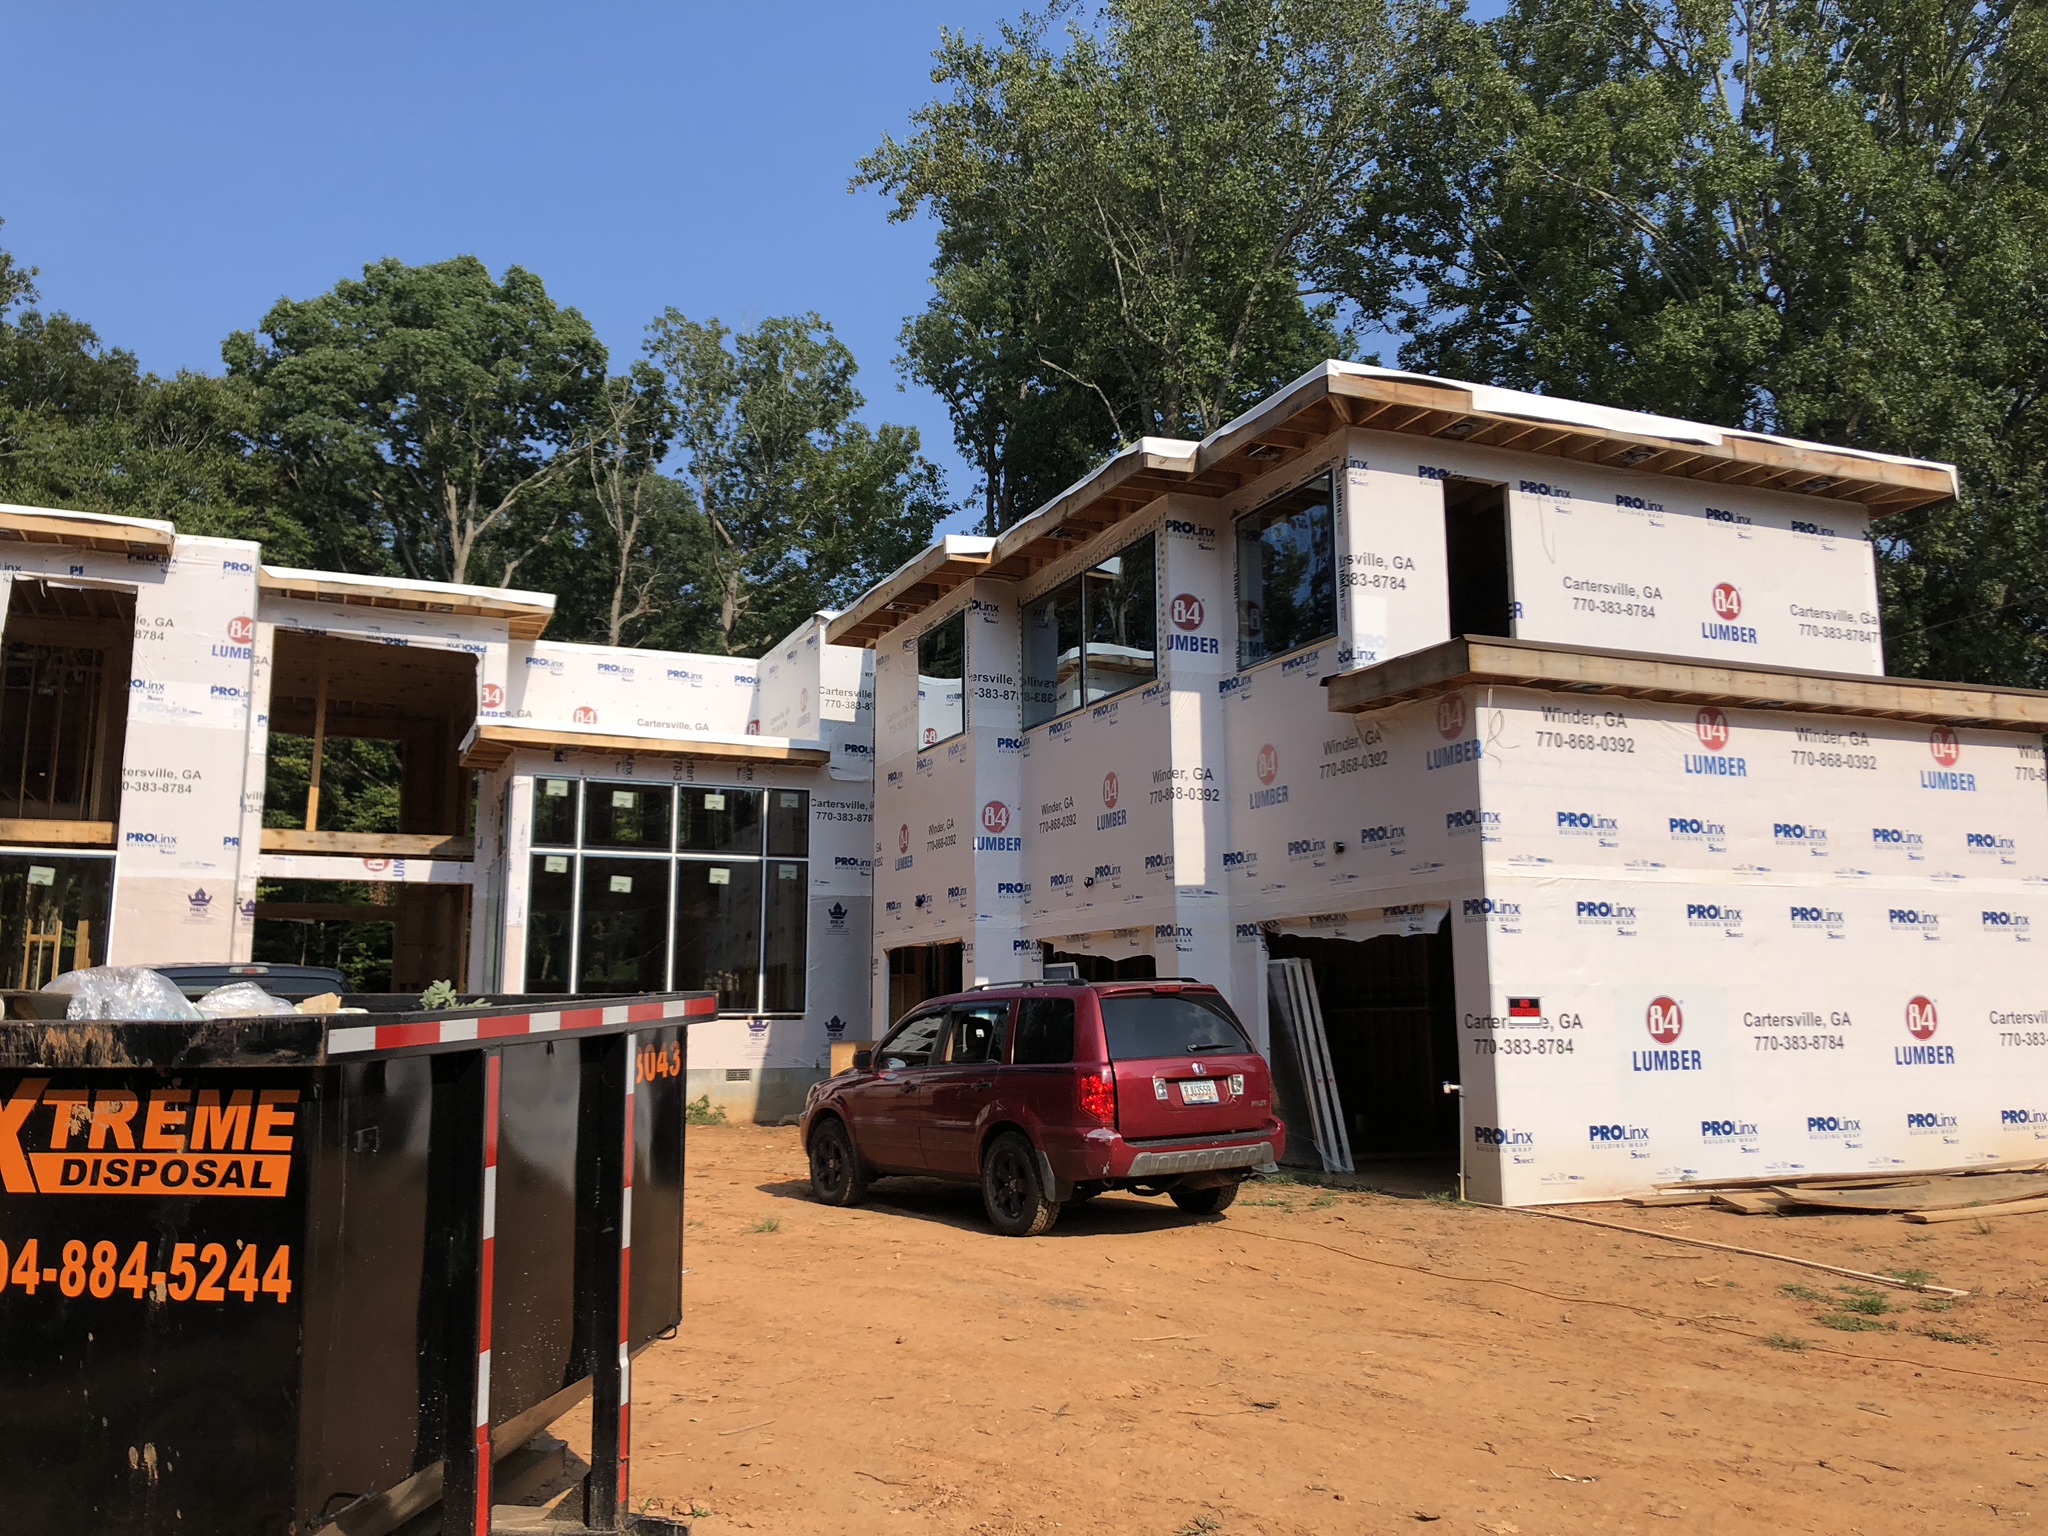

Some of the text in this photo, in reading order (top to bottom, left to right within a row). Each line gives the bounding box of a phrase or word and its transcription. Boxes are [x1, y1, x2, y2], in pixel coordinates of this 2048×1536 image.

[1519, 480, 1572, 499] PROLinx
[1615, 495, 1664, 513] PROLinx
[1705, 508, 1751, 526] PROLinx
[1165, 519, 1215, 537] PROLinx
[1791, 521, 1835, 538] PROLinx
[1392, 556, 1415, 571] GA
[1562, 576, 1663, 600] Cartersville, GA
[1572, 598, 1656, 619] 770-383-8784
[1790, 604, 1857, 625] Cartersville,
[155, 618, 174, 628] GA
[1701, 622, 1758, 644] LUMBER
[525, 657, 564, 668] PROLinx
[597, 663, 634, 674] PROLinx
[1281, 651, 1319, 671] PROLinx
[667, 670, 702, 680] PROLinx
[1142, 682, 1171, 699] PROLinx
[1218, 675, 1253, 693] PROLinx
[1093, 702, 1118, 719] PROLinx
[1541, 706, 1628, 729] Winder, GA
[637, 718, 709, 731] Cartersville, GA
[1049, 721, 1072, 735] PROLinx
[997, 737, 1030, 750] PROLinx
[1365, 730, 1382, 745] GA
[1535, 731, 1635, 753] 770-868-0392
[1795, 727, 1870, 748] Winder, GA
[1426, 739, 1482, 771] LUMBER
[1791, 750, 1877, 770] 770-868-0392
[1320, 751, 1388, 779] 770-868-0392
[1684, 754, 1747, 777] LUMBER
[182, 770, 202, 779] GA
[888, 771, 903, 783] PROLinx
[1152, 768, 1214, 784] Winder, GA
[1920, 770, 1977, 792] LUMBER
[1150, 787, 1220, 804] 770-868-0392
[1249, 785, 1289, 810] LUMBER
[811, 799, 868, 811] Cartersville,
[1040, 797, 1074, 816] Winder, GA
[947, 818, 954, 830] GA
[1039, 814, 1077, 834] 770-868-0392
[1096, 810, 1127, 831] LUMBER
[1445, 808, 1501, 829] PROLinx
[1557, 811, 1618, 831] PROLinx
[1669, 817, 1726, 835] PROLinx
[126, 832, 177, 844] PROLinx
[1361, 825, 1406, 843] PROLinx
[1773, 823, 1828, 840] PROLinx
[1872, 828, 1923, 844] PROLinx
[973, 837, 1022, 851] LUMBER
[1288, 838, 1326, 855] PROLinx
[1599, 839, 1619, 848] Select
[1708, 844, 1727, 852] Select
[1967, 833, 2015, 849] PROLinx
[1145, 853, 1174, 868] PROLinx
[1223, 850, 1258, 866] PROLinx
[1095, 863, 1121, 877] PROLinx
[1050, 873, 1074, 886] PROLinx
[948, 886, 967, 898] PROLinx
[998, 882, 1032, 894] PROLinx
[1463, 898, 1521, 916] PROLinx
[1576, 901, 1636, 918] PROLinx
[1687, 904, 1743, 921] PROLinx
[1790, 906, 1844, 923] PROLinx
[1889, 909, 1939, 925] PROLinx
[1982, 911, 2030, 926] PROLinx
[1155, 924, 1193, 938] PROLinx
[1500, 924, 1522, 934] Select
[1617, 927, 1637, 937] Select
[1725, 929, 1744, 938] Select
[1827, 930, 1845, 939] Select
[1559, 1013, 1583, 1029] GA
[1743, 1012, 1852, 1029] Cartersville, GA
[1474, 1039, 1574, 1055] 770-383-8784
[1753, 1035, 1844, 1051] 770-383-8784
[1633, 1050, 1702, 1072] LUMBER
[1894, 1046, 1955, 1065] LUMBER
[1807, 1117, 1862, 1132] PROLinx
[1907, 1113, 1958, 1127] PROLinx
[2001, 1109, 2048, 1124] PROLinx
[1474, 1126, 1534, 1144] PROLinx
[1589, 1124, 1649, 1141] PROLinx
[1701, 1120, 1758, 1136] PROLinx
[1740, 1145, 1759, 1154] Select
[1845, 1140, 1863, 1149] Select
[1513, 1155, 1534, 1164] Select
[1630, 1150, 1650, 1160] Select
[59, 1158, 273, 1189] DISPOSAL
